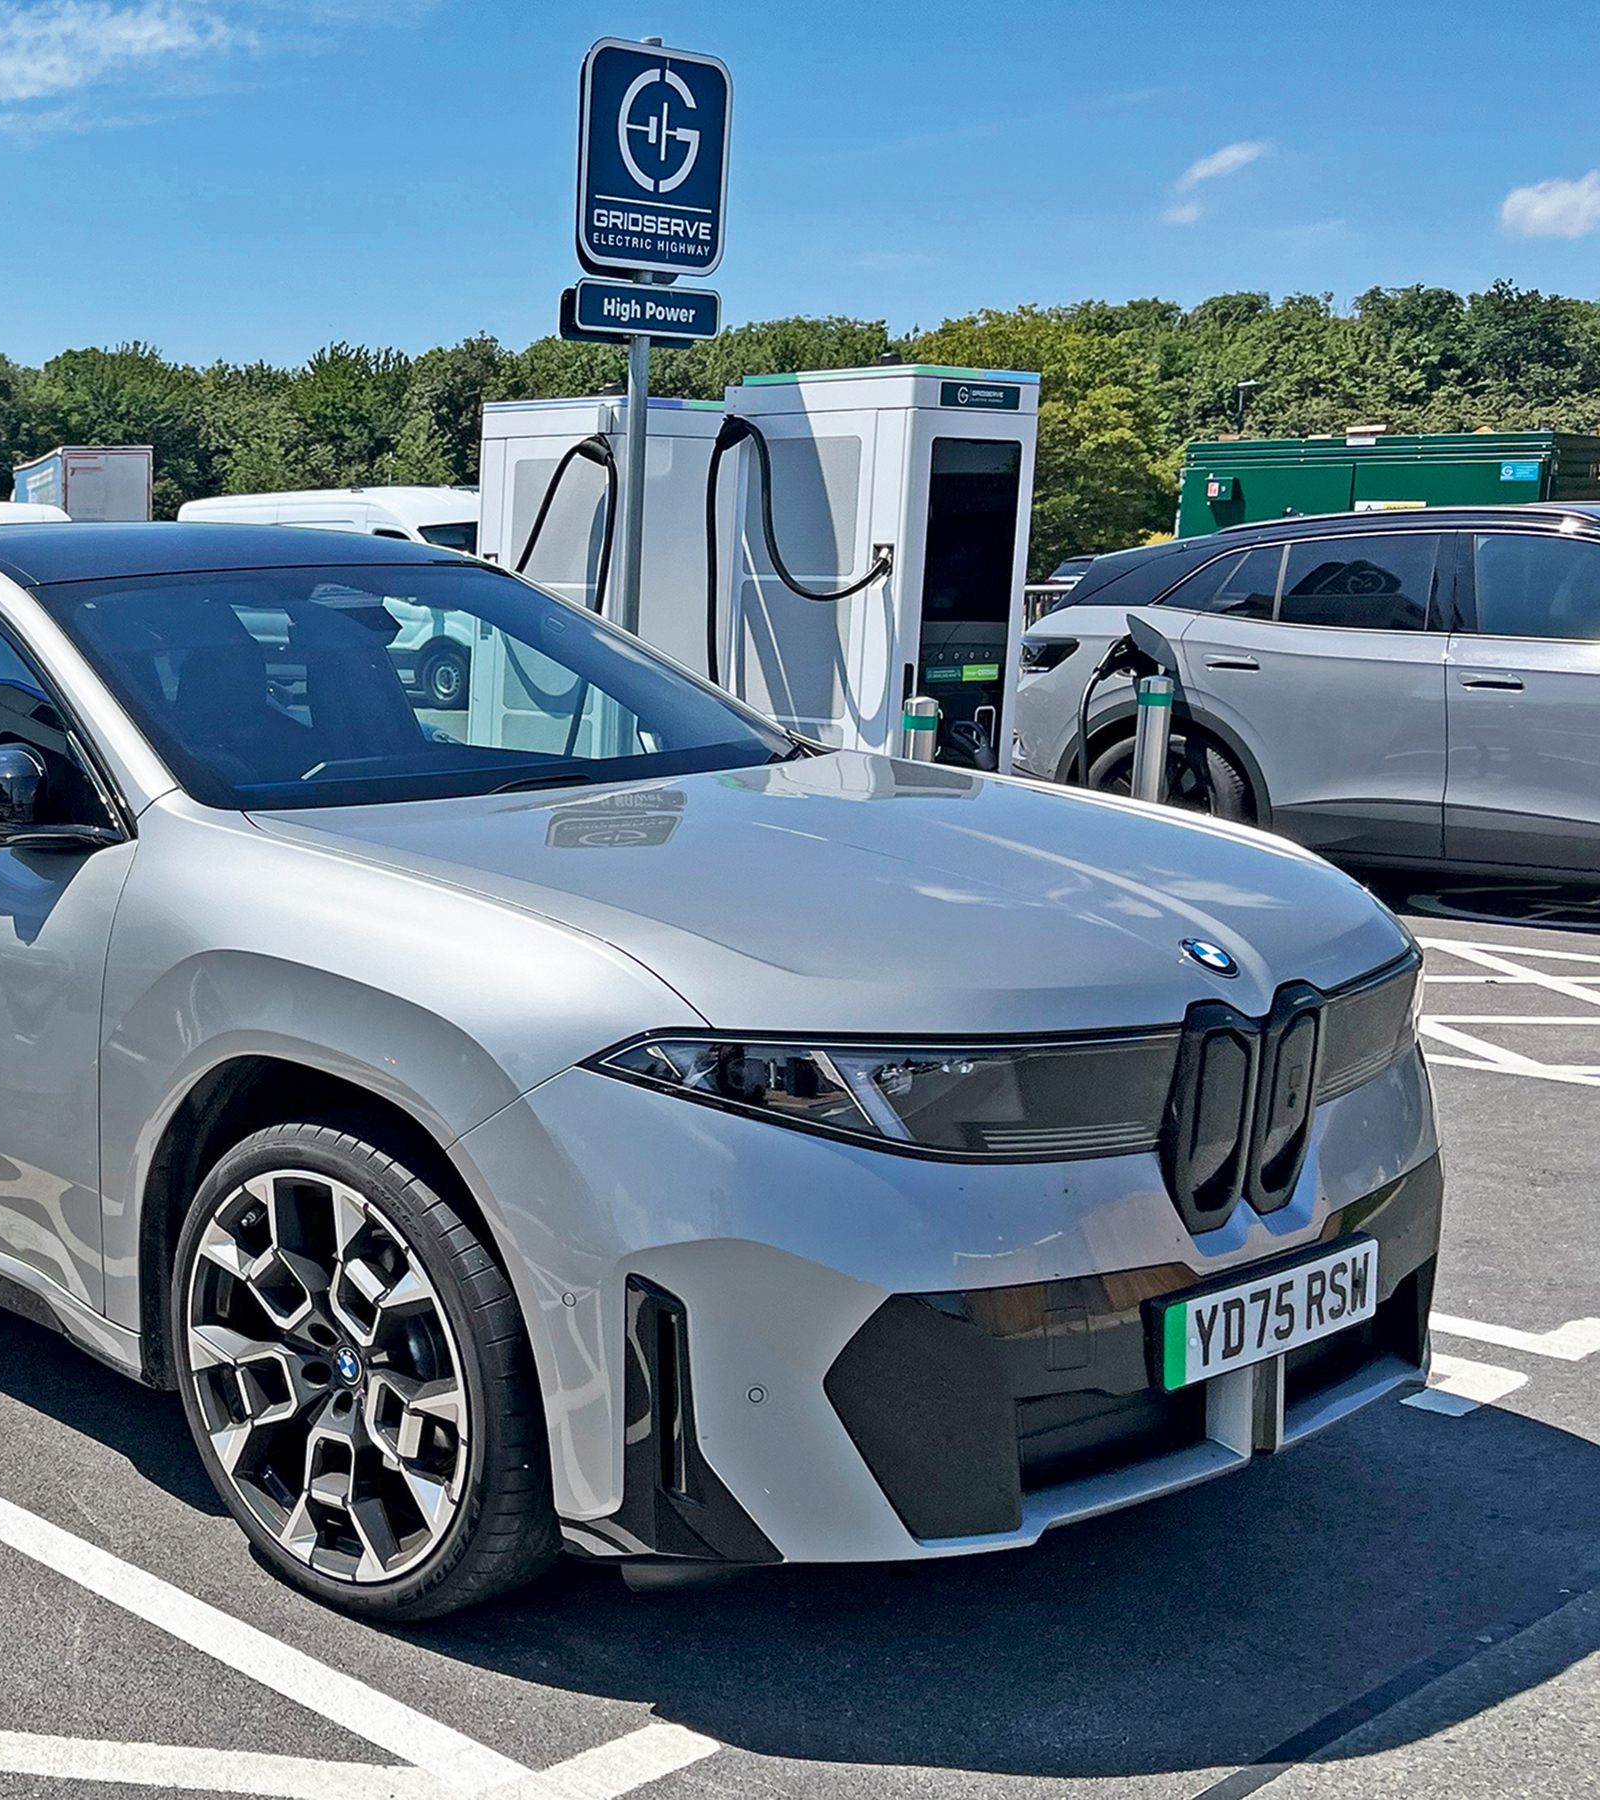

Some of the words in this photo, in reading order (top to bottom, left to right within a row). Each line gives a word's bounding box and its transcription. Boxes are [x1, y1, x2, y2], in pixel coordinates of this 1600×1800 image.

[593, 208, 712, 241] GRIDSERVE
[593, 232, 652, 250] ELECTRIC
[657, 240, 711, 256] HIGHWAY
[603, 297, 641, 322] High
[645, 301, 696, 323] Power
[1195, 1279, 1294, 1367] YD75
[1305, 1251, 1371, 1331] RSW
